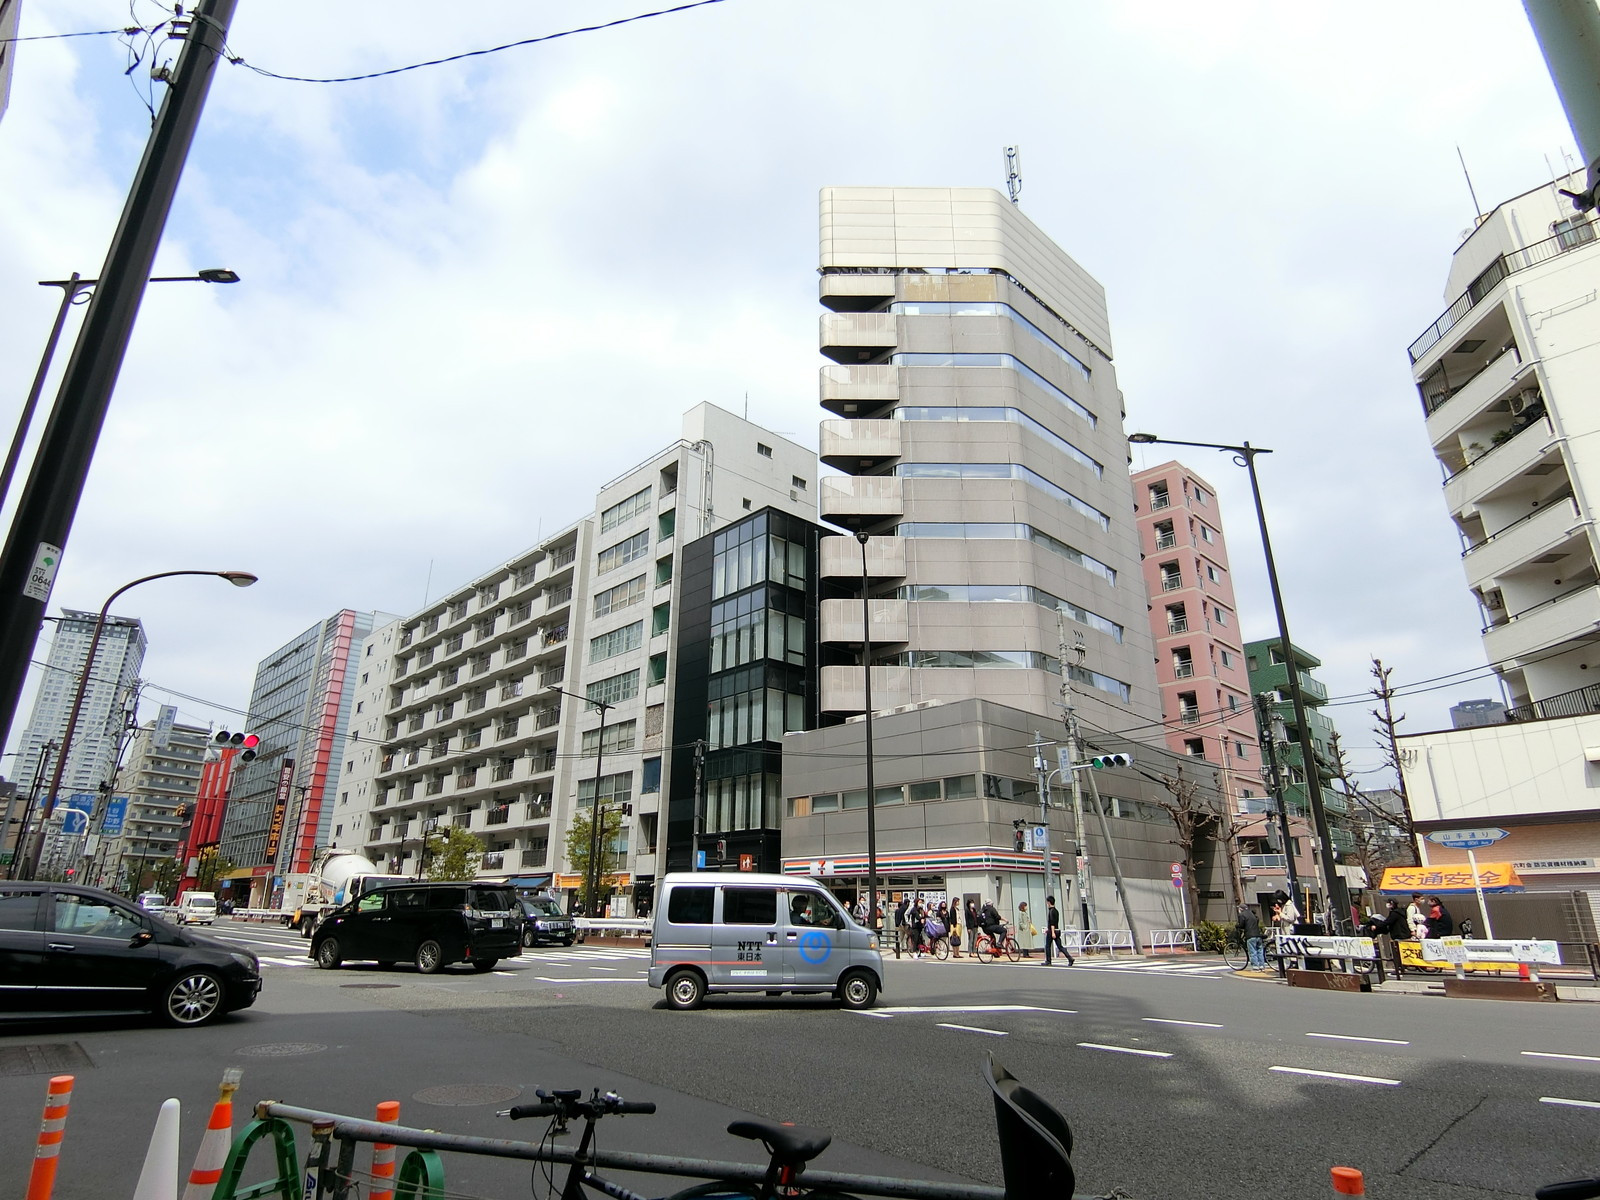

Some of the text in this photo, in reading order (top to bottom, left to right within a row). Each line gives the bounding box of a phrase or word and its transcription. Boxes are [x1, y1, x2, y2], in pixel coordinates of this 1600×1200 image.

[32, 574, 51, 587] 0644
[1443, 832, 1489, 840] 山手通り
[1389, 870, 1502, 886] 交通安全
[737, 941, 763, 951] NTT
[737, 952, 762, 961] 東日本
